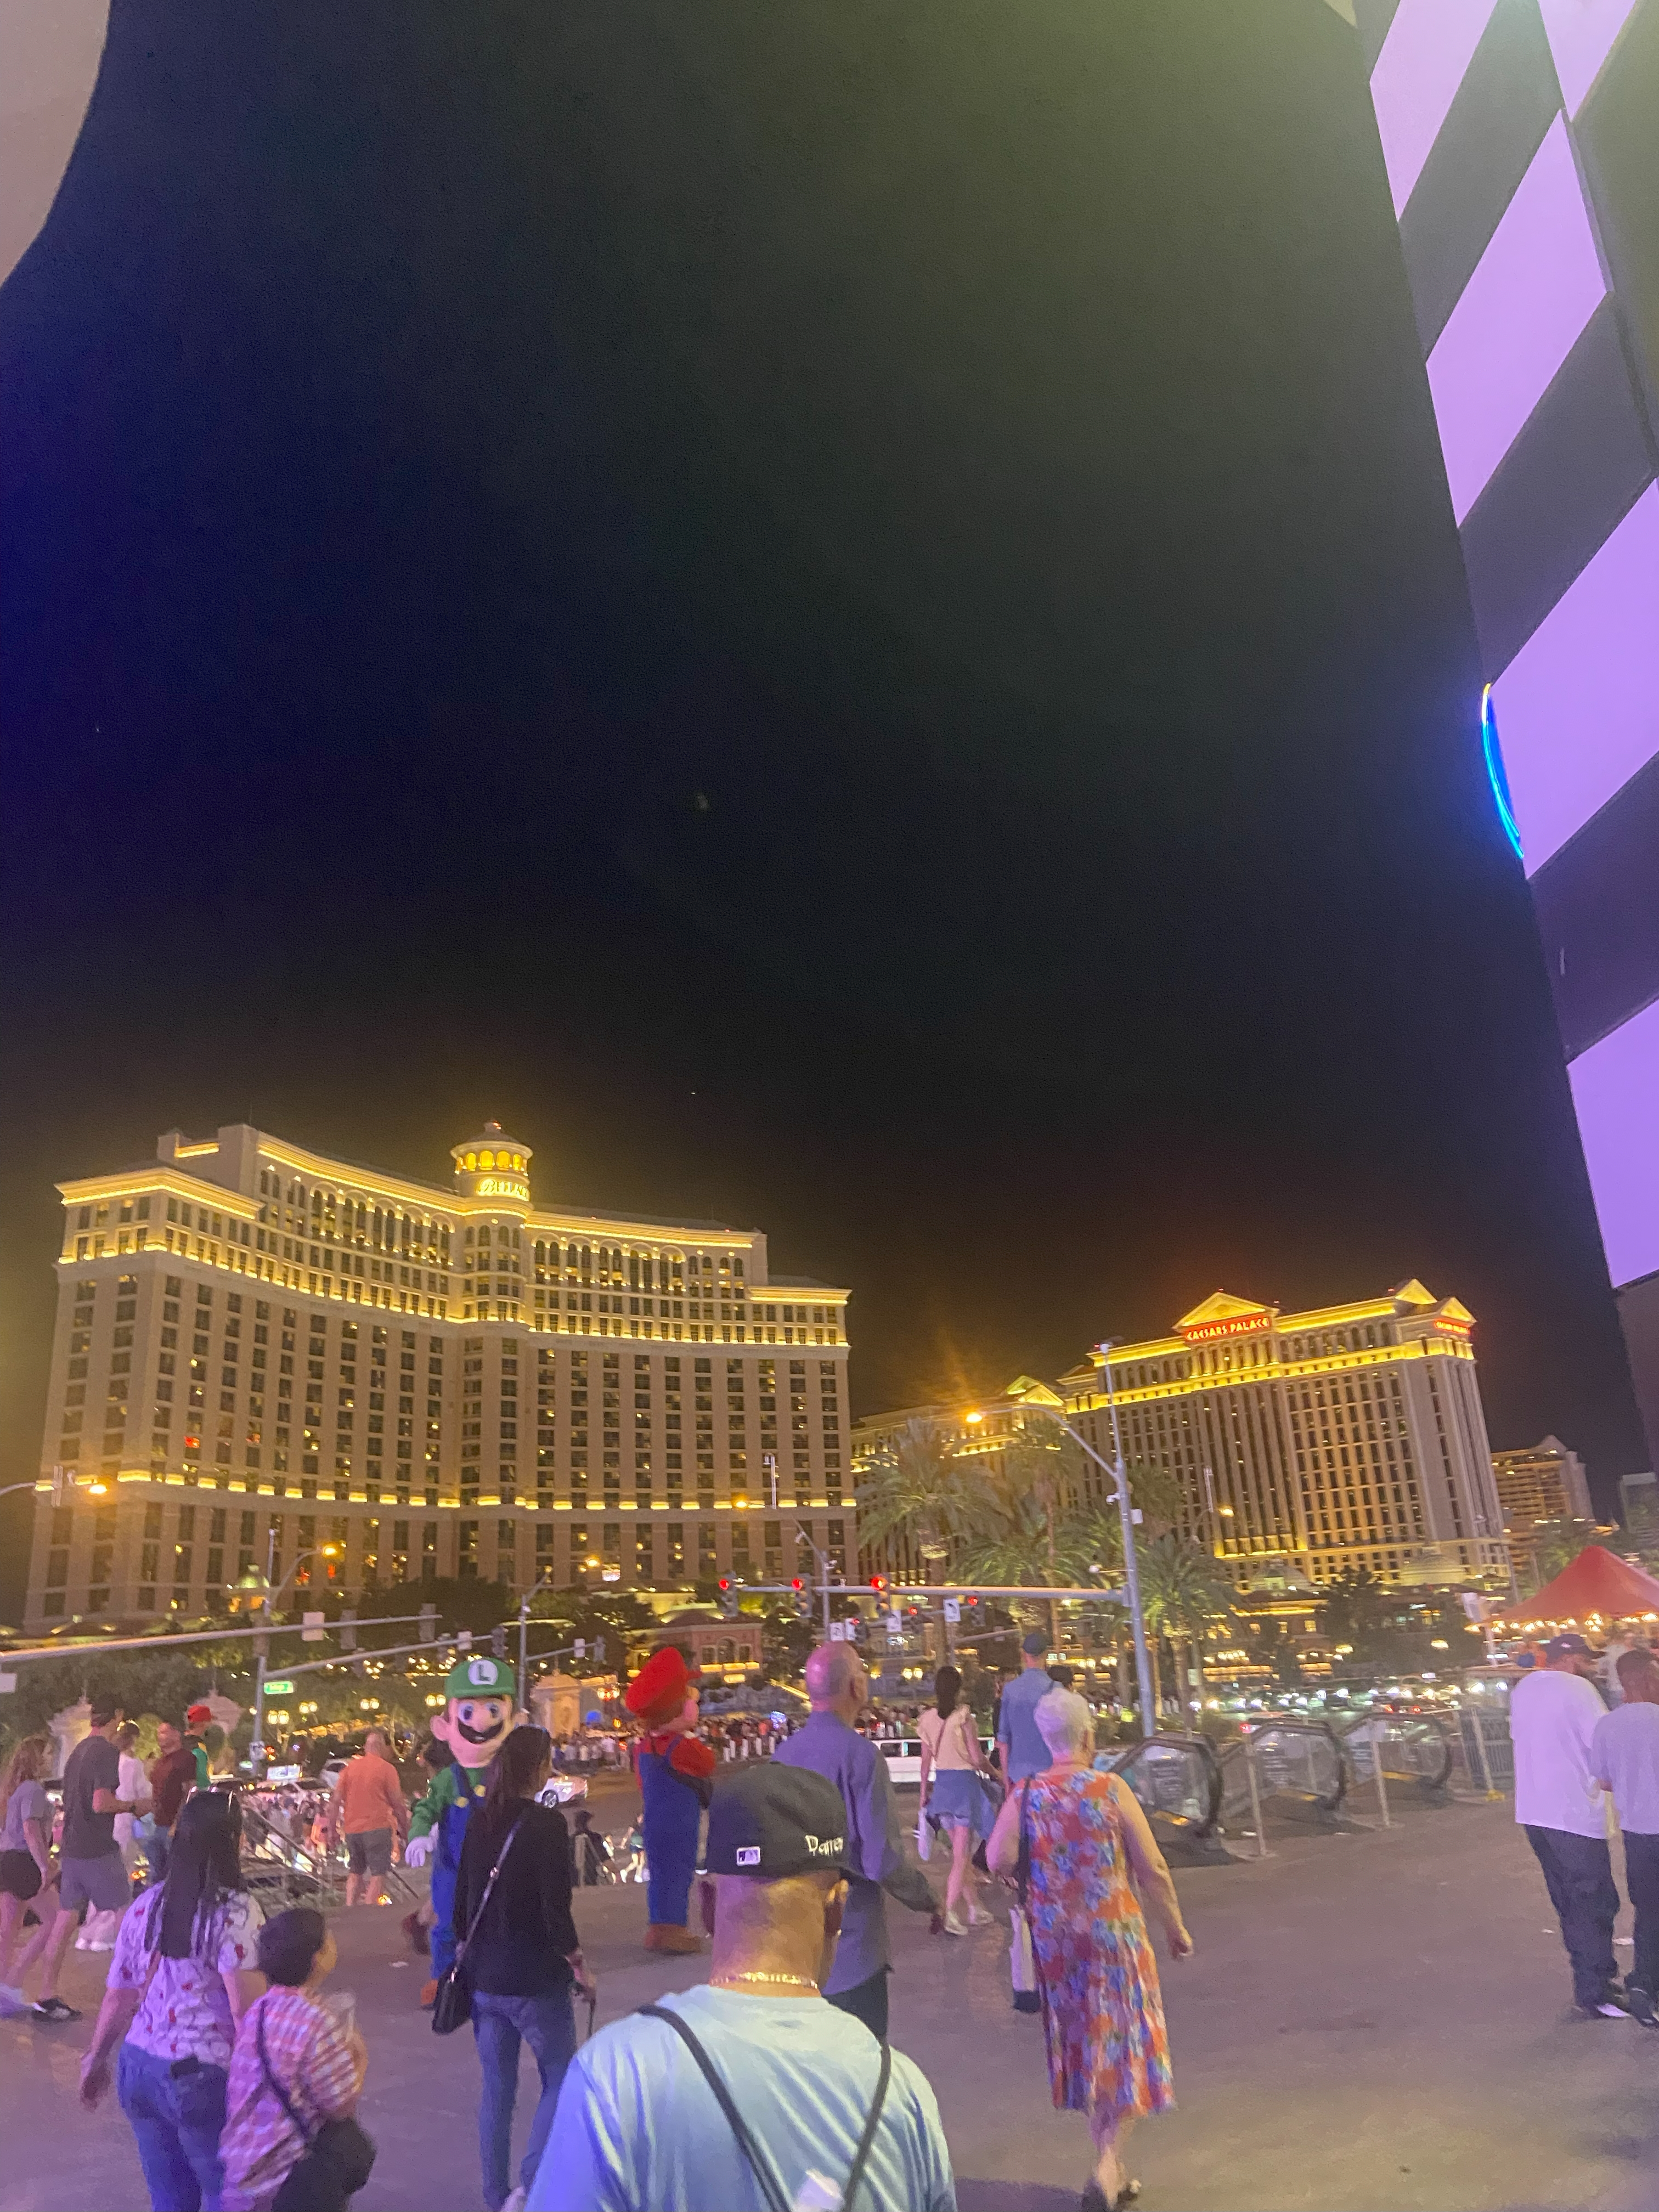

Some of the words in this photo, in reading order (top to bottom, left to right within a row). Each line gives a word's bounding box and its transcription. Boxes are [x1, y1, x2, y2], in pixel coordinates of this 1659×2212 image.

[1187, 1325, 1228, 1341] CAESARS
[1229, 1317, 1269, 1333] PALACE
[478, 1664, 492, 1681] L
